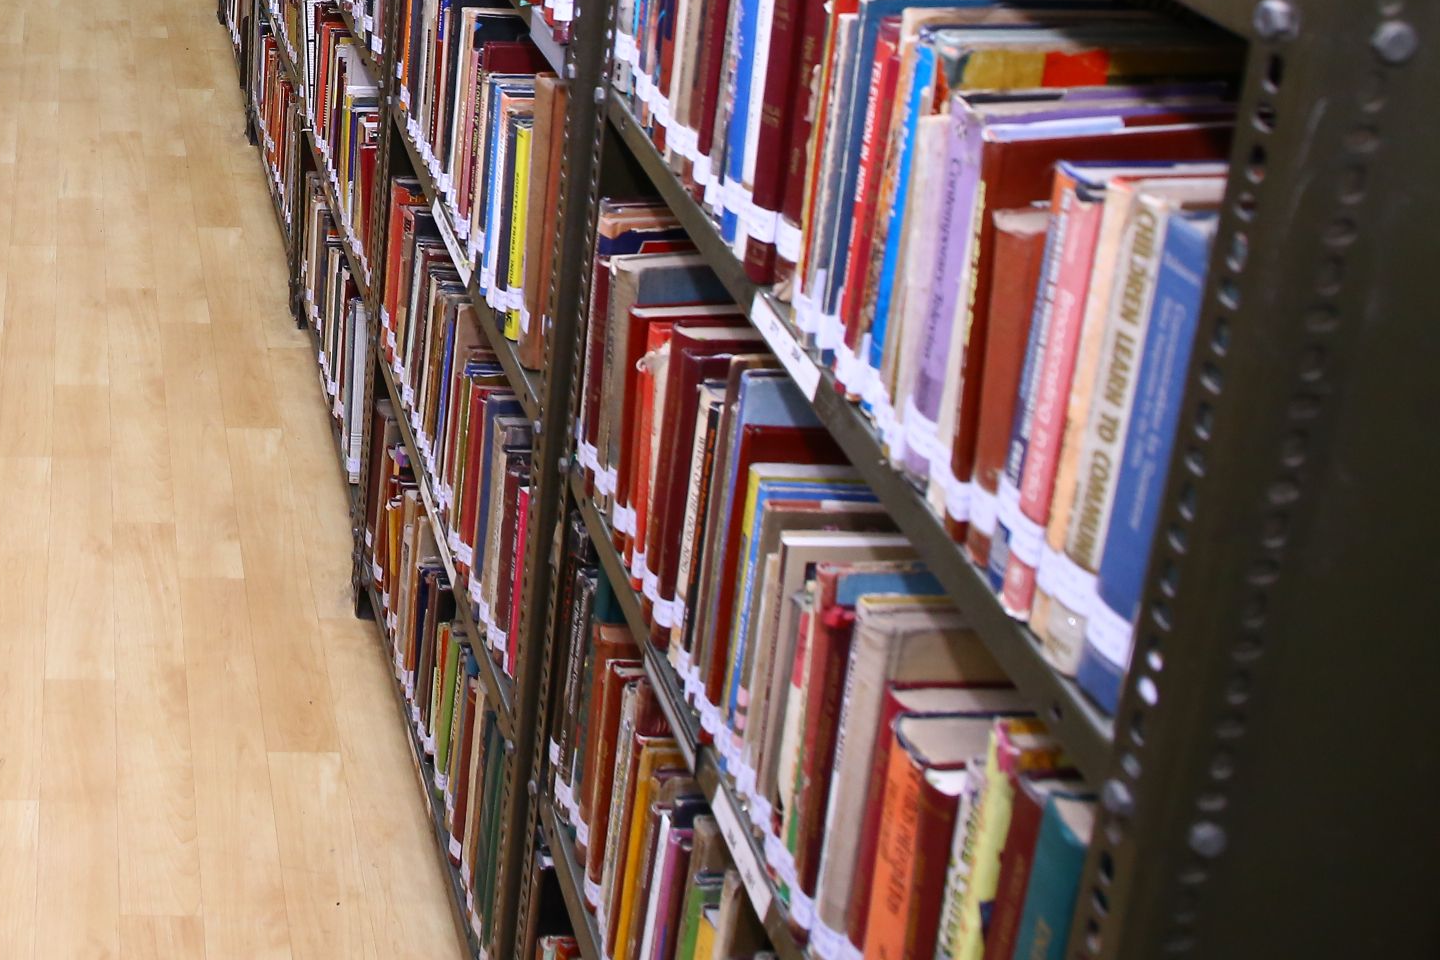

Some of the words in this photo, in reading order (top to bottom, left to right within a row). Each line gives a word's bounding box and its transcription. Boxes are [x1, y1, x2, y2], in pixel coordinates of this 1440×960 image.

[862, 60, 883, 144] TELEVISION
[853, 165, 868, 203] INDIA
[860, 144, 871, 162] IN
[932, 157, 964, 287] Contemporary
[1120, 208, 1160, 325] CHILDREN
[1035, 289, 1077, 425] Broadcasting
[1103, 331, 1137, 405] LEARN
[1032, 428, 1051, 450] in
[1097, 412, 1121, 445] TO
[1024, 451, 1047, 503] India
[1072, 449, 1112, 561] COMMUN
